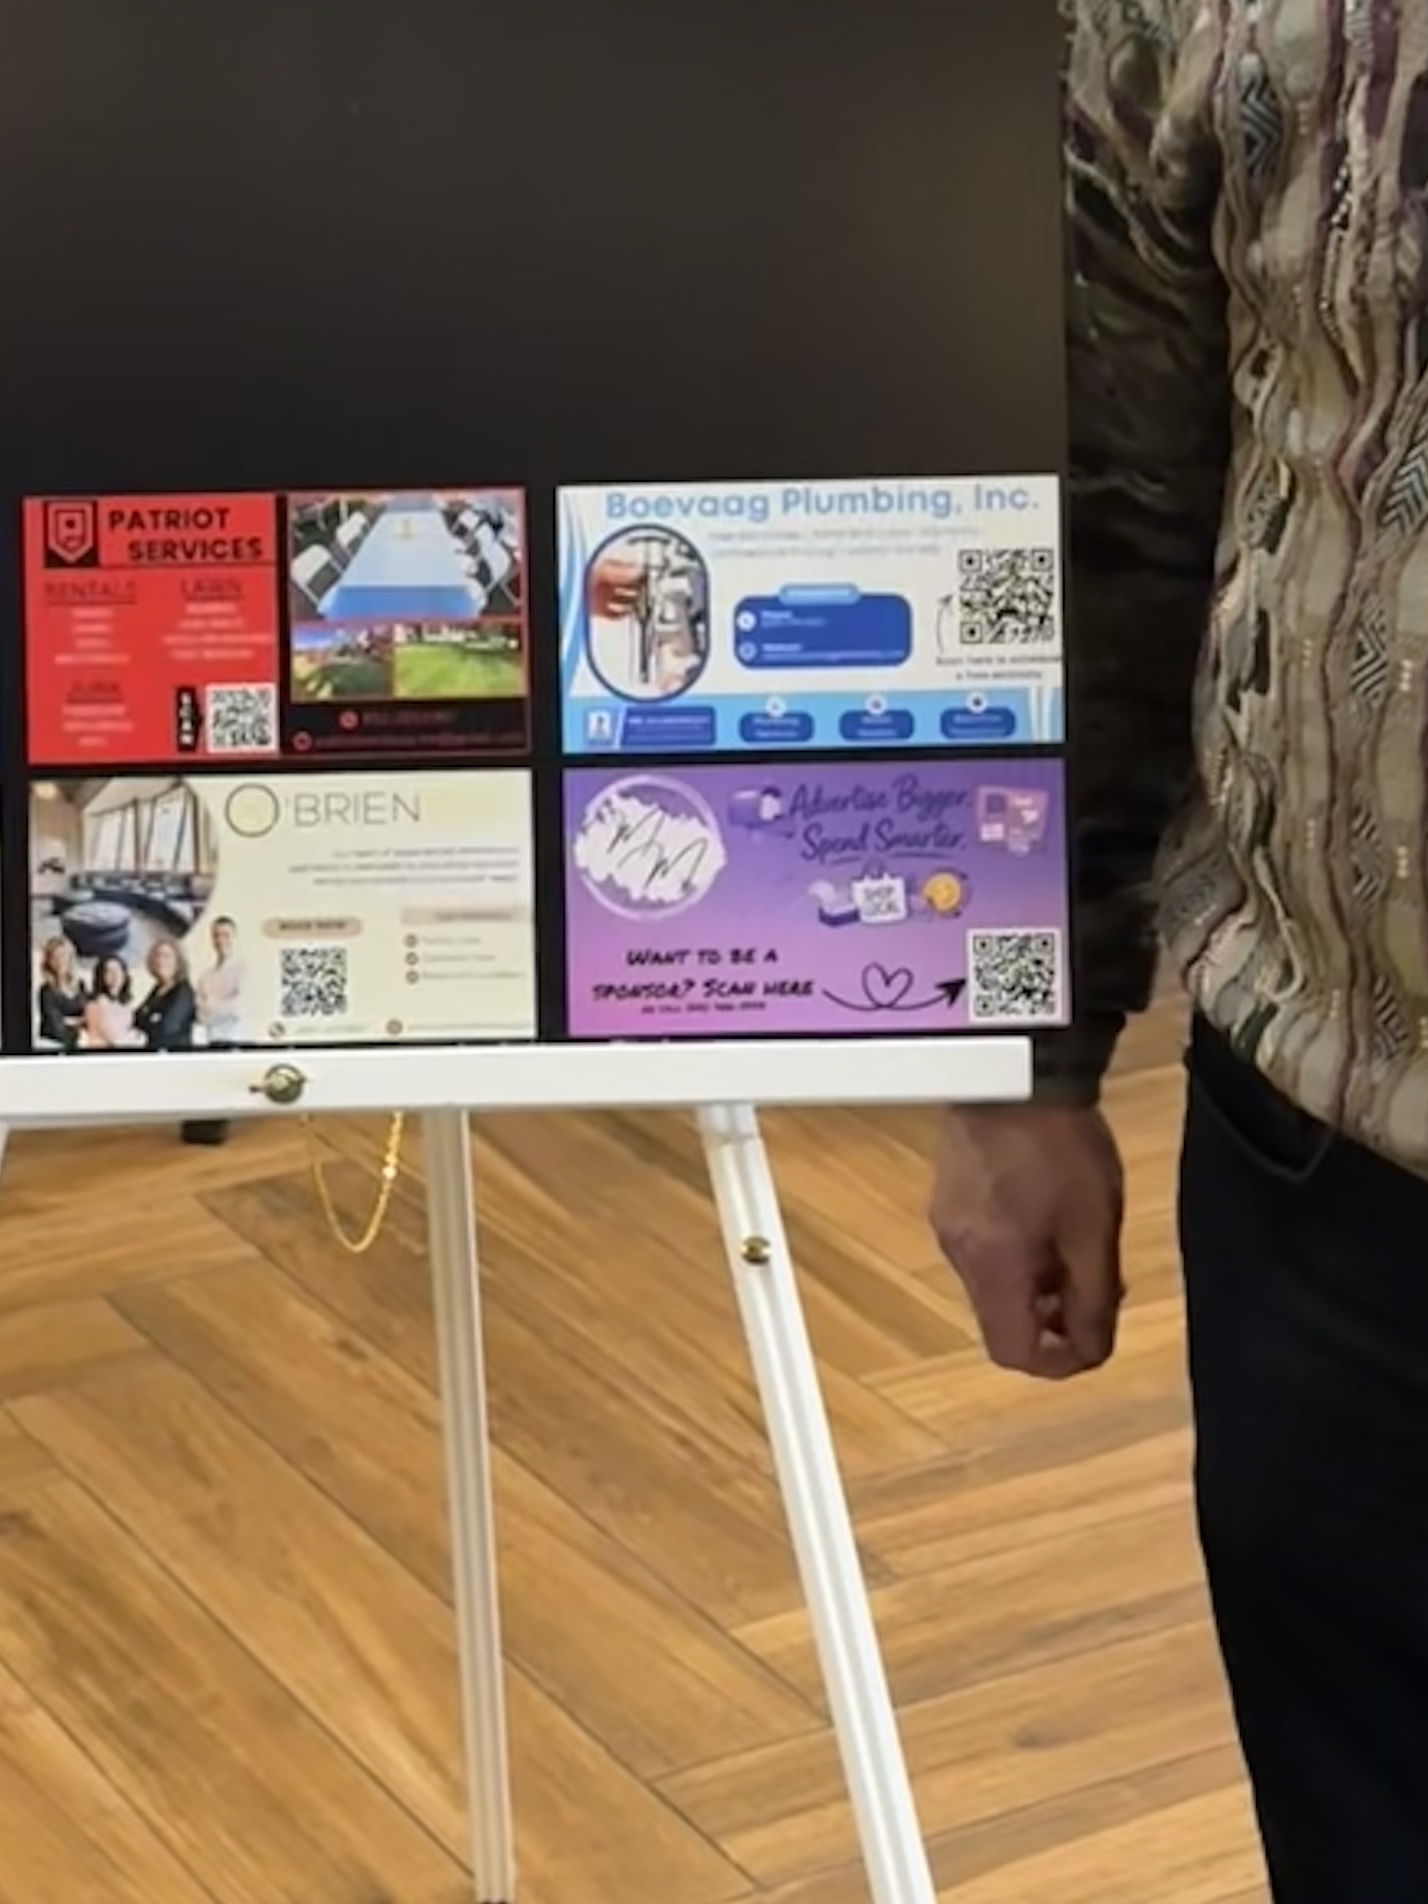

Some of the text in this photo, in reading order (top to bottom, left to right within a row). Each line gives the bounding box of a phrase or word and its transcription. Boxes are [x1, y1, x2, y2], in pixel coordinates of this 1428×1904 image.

[605, 483, 1041, 522] Boevaag Plumbing, Inc.
[109, 507, 231, 532] PATRIOT
[128, 536, 263, 561] SERVICES
[789, 783, 889, 821] Advertise
[800, 822, 870, 864] Spend
[626, 948, 778, 966] WANT TO BE A
[592, 978, 815, 1000] SPONSOR? SCAN HERE
